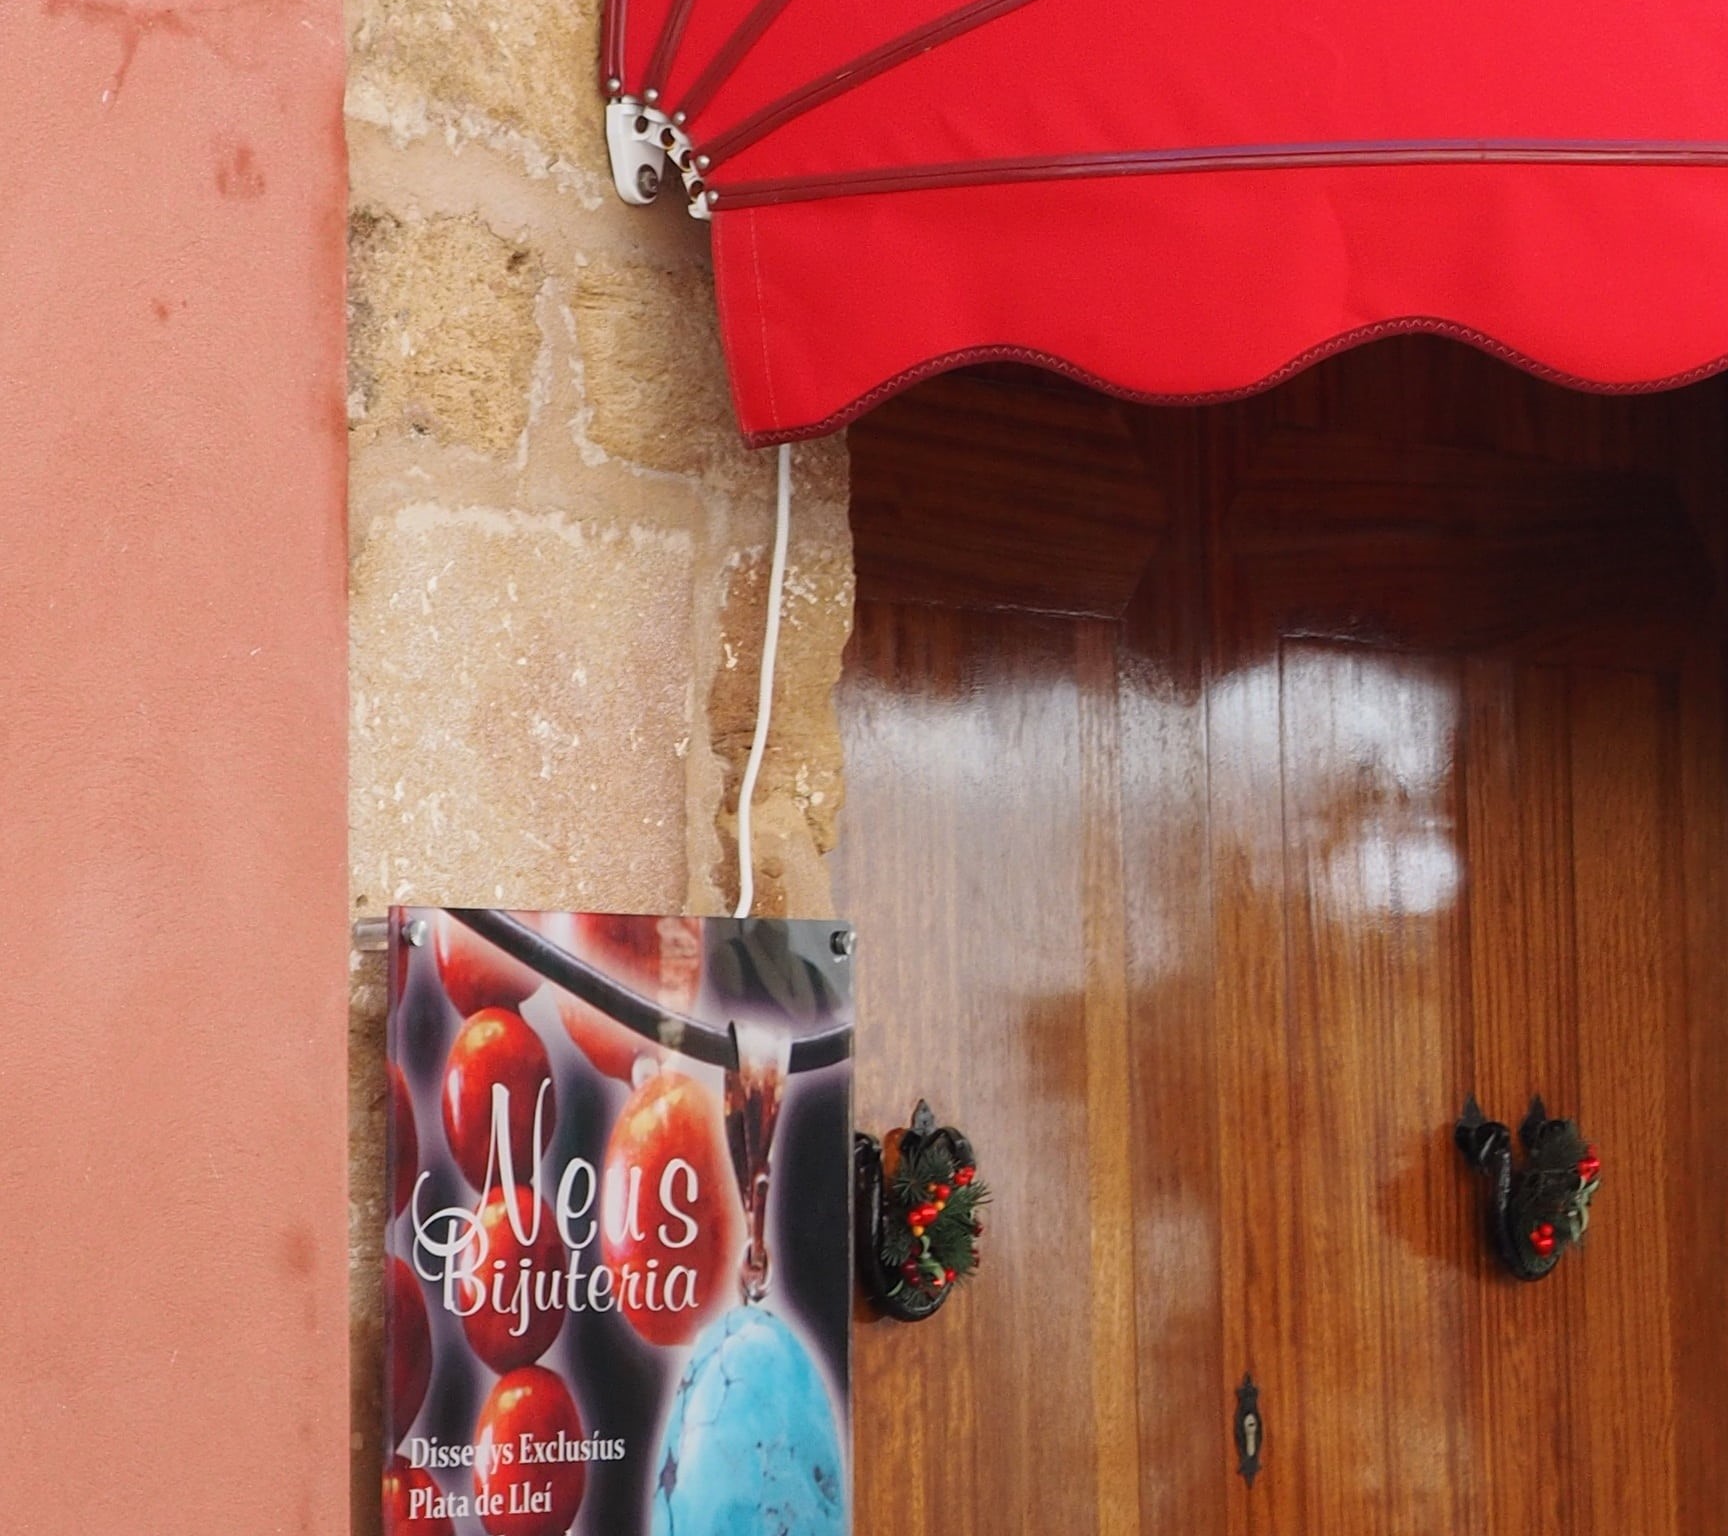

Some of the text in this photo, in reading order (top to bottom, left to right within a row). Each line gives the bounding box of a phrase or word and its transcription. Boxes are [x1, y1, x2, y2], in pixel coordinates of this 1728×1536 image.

[412, 1077, 700, 1257] Neus
[412, 1206, 700, 1338] Bijuteria
[408, 1485, 470, 1520] Plata
[474, 1482, 504, 1516] de
